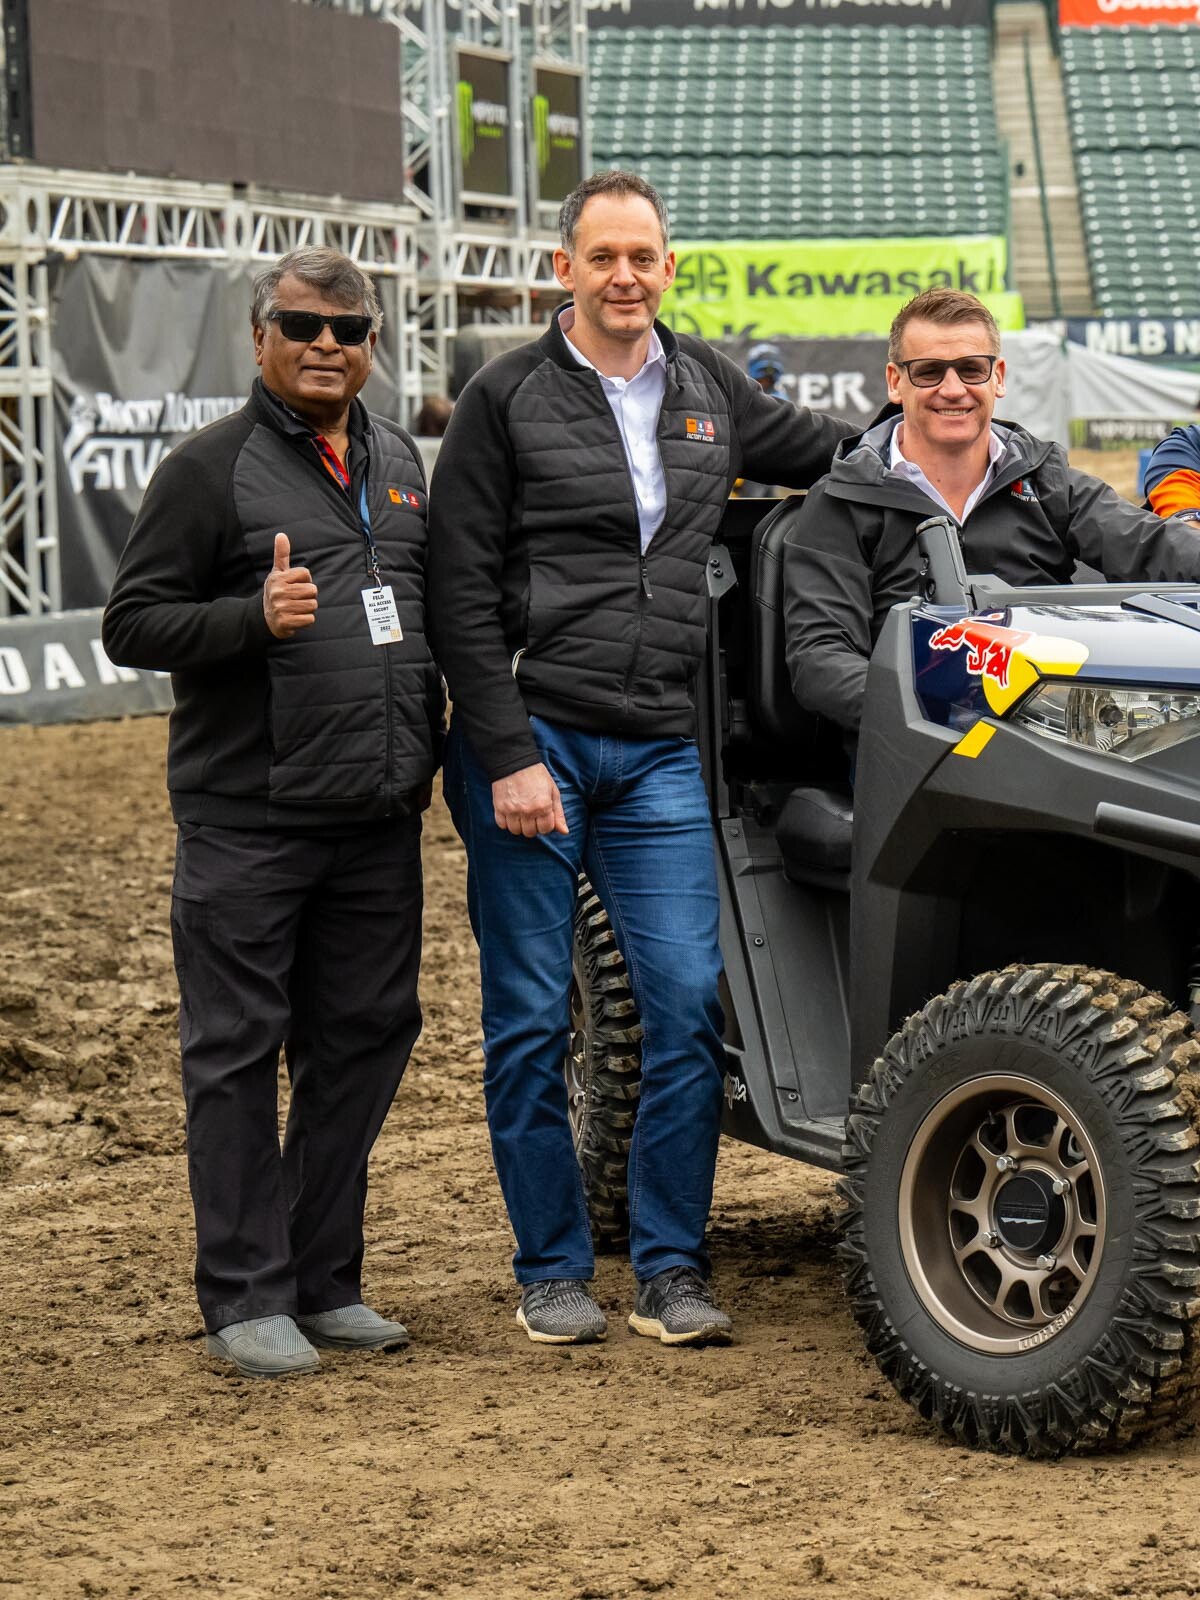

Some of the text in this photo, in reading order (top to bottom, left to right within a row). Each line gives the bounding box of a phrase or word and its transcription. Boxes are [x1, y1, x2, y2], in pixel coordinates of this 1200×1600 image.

[746, 257, 996, 297] Kawasaki
[1086, 321, 1167, 354] MLB
[1018, 1303, 1077, 1351] METHOD
